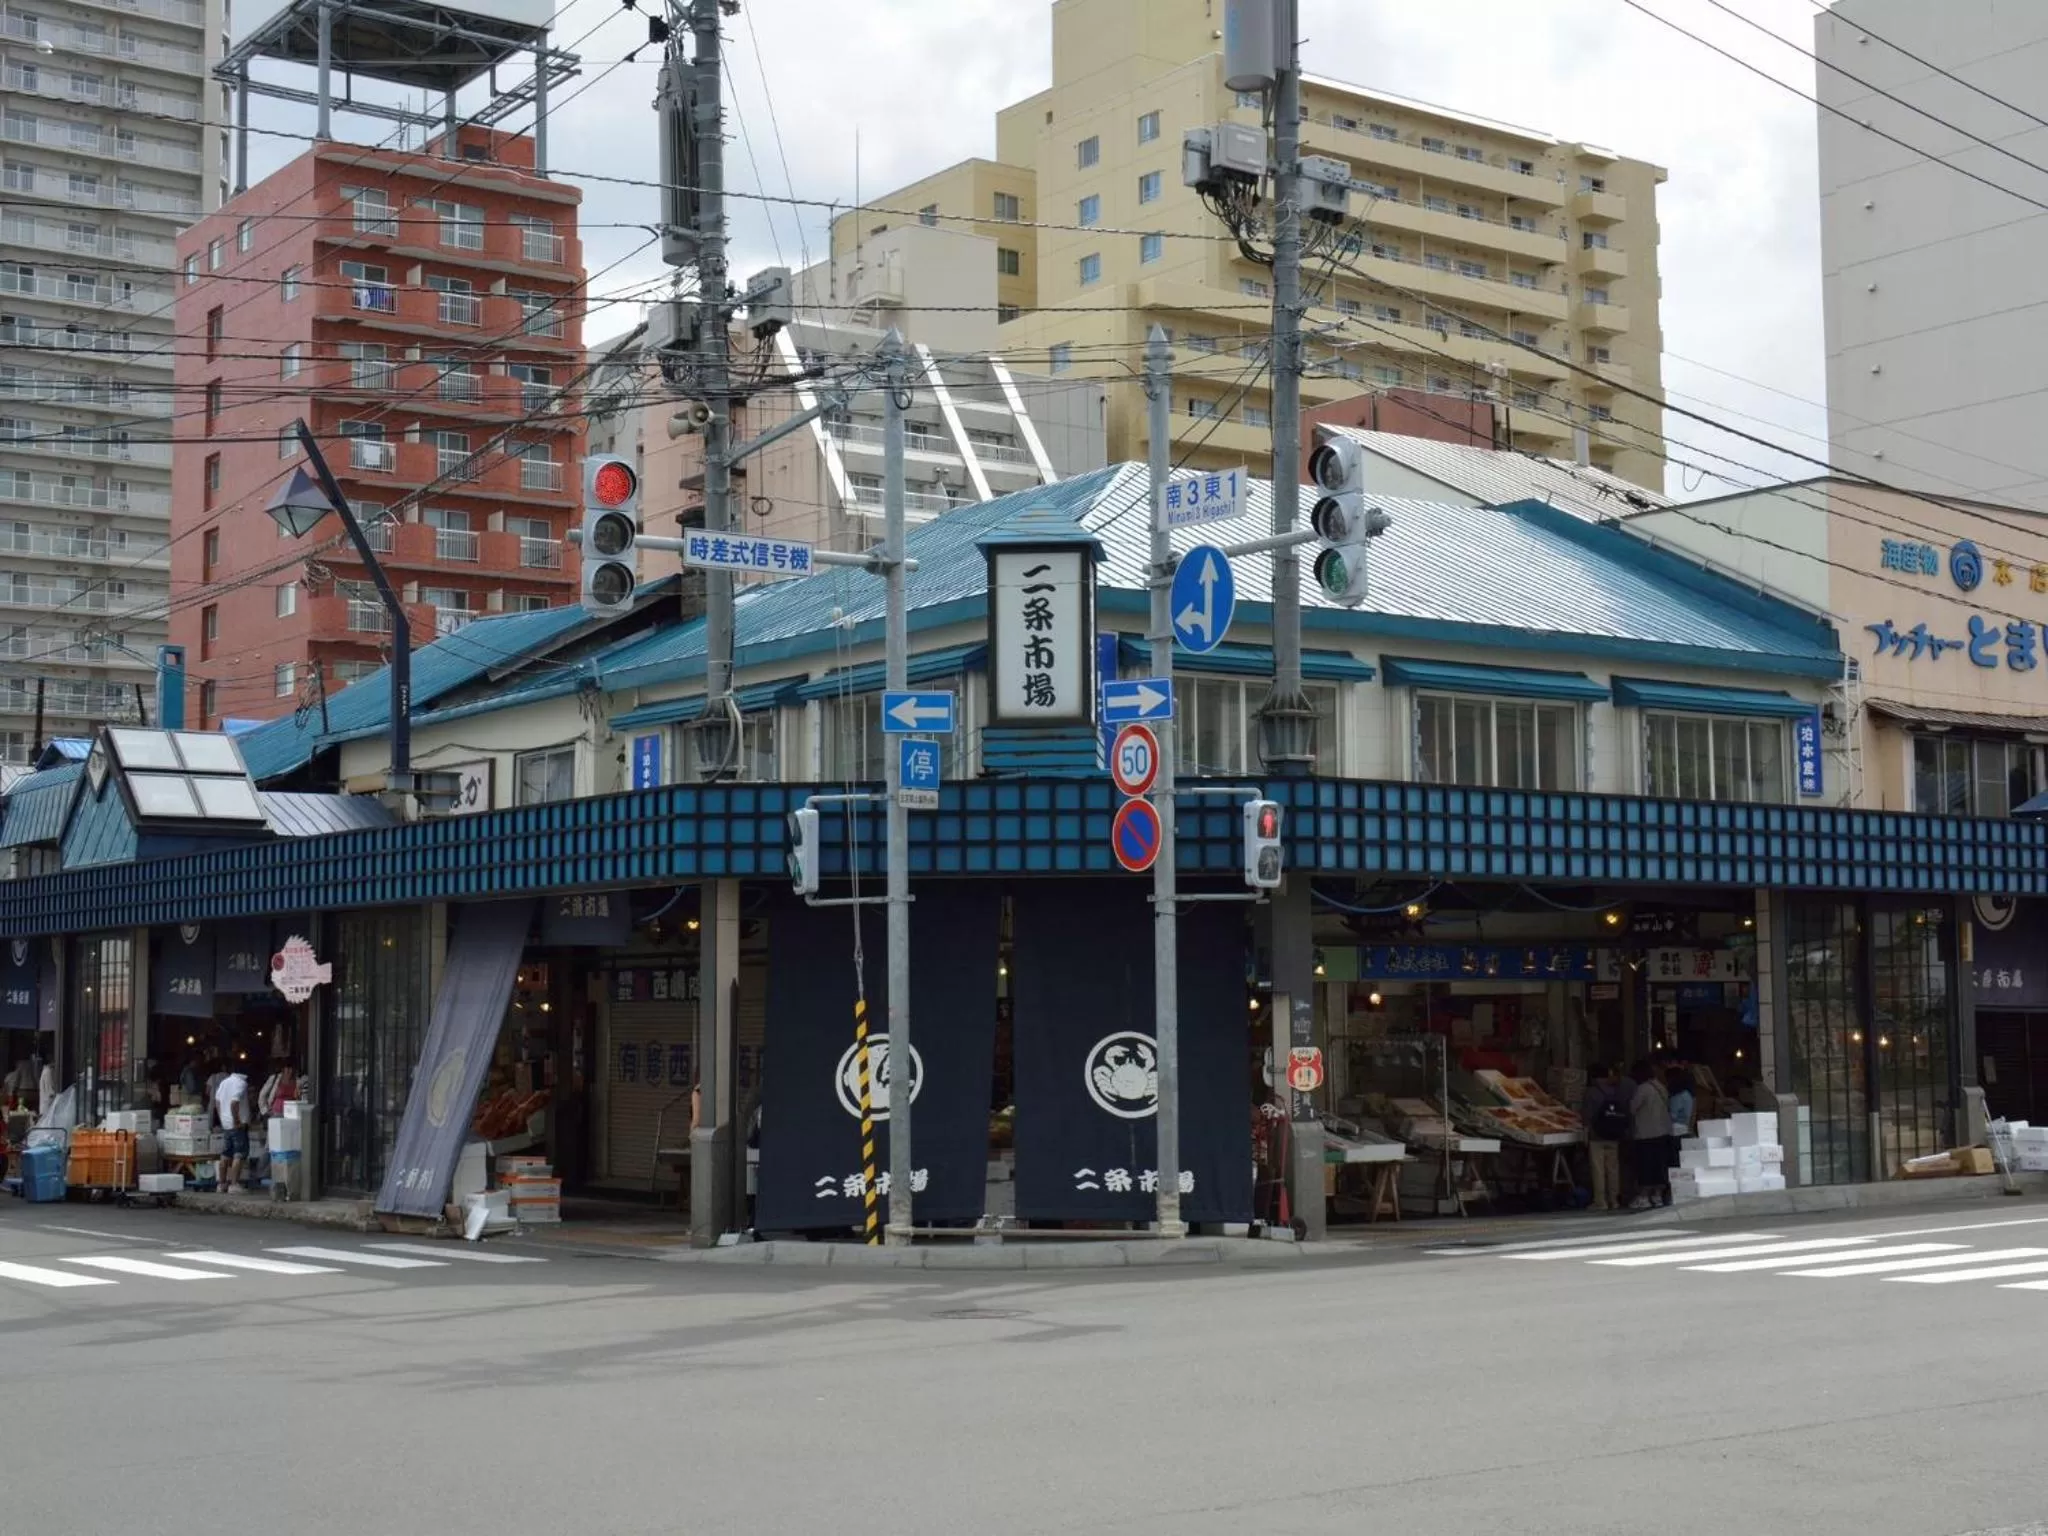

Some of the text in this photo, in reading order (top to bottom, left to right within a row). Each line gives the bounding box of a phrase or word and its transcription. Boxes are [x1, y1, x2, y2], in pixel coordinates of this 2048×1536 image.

[690, 536, 809, 570] 時差式信号機
[1880, 539, 1939, 577] 海産物
[1021, 564, 1057, 708] 二条市場
[906, 749, 934, 780] 停
[1122, 744, 1148, 776] 50
